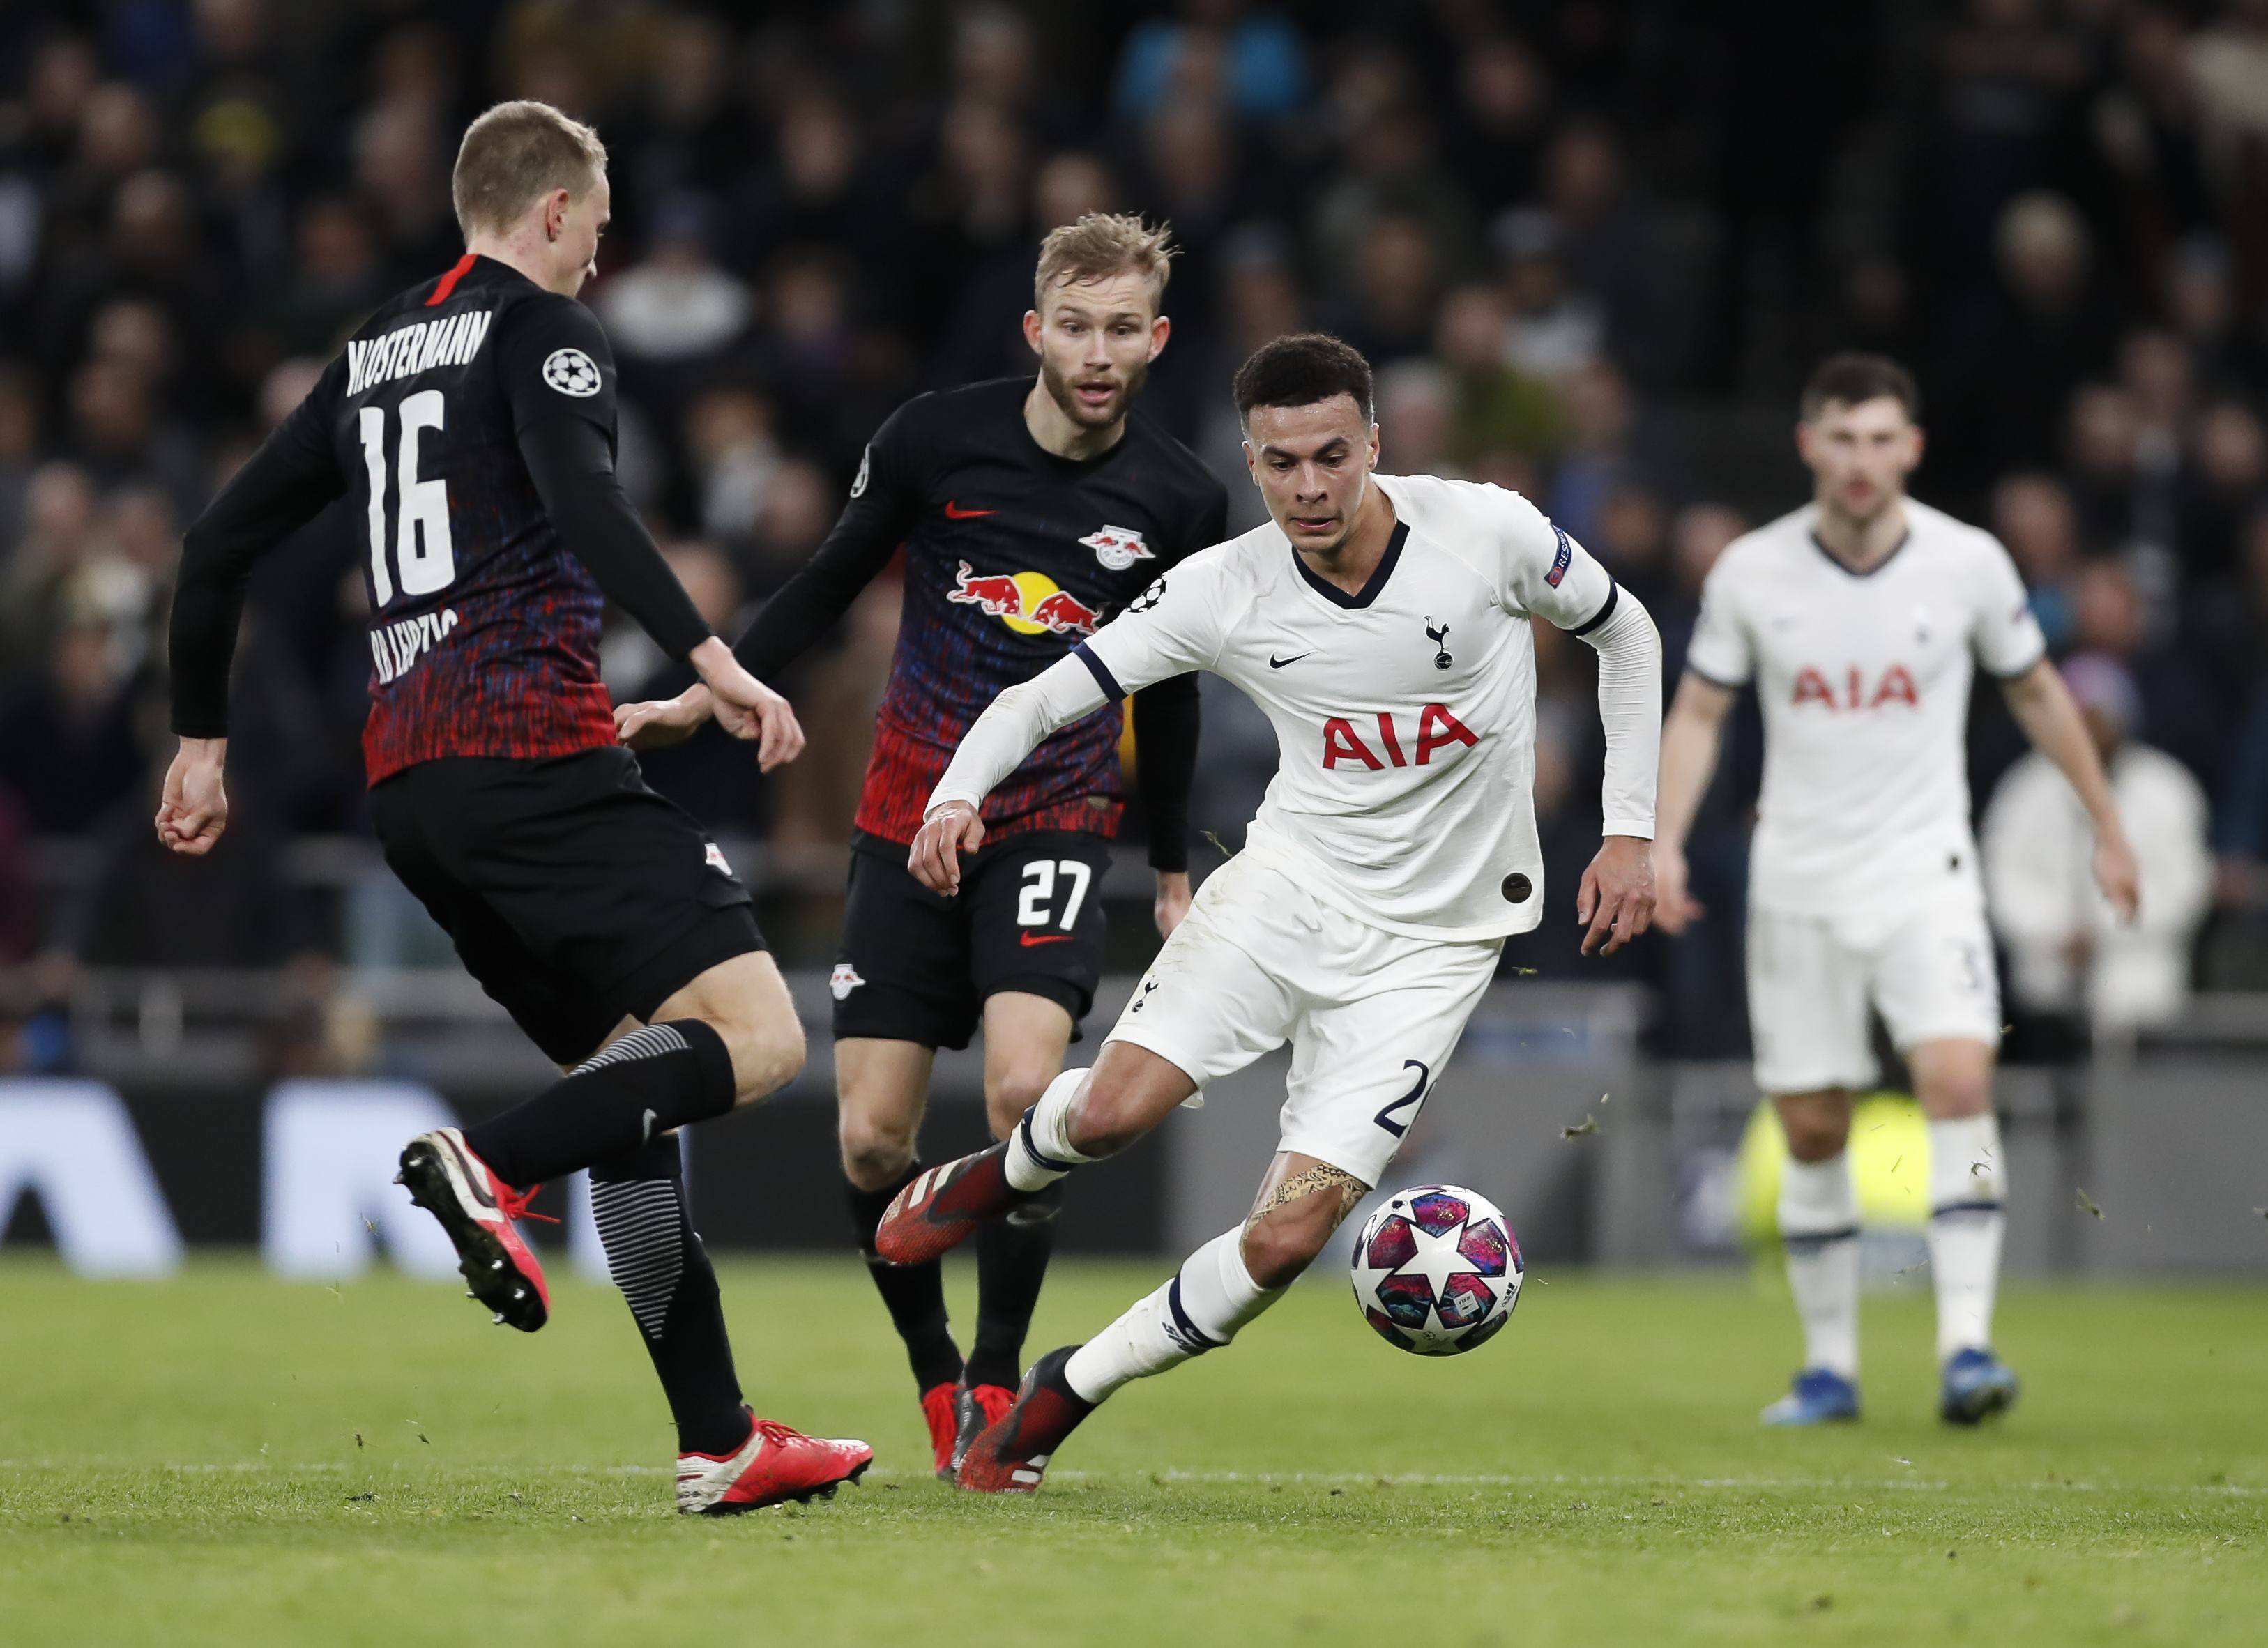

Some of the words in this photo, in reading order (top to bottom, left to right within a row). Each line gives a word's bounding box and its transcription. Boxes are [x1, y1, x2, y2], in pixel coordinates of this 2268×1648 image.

[359, 389, 455, 608] 16
[1791, 664, 1920, 710] AIA
[1323, 703, 1479, 770] AIA
[1017, 860, 1091, 931] 27
[1373, 1059, 1438, 1139] 2
